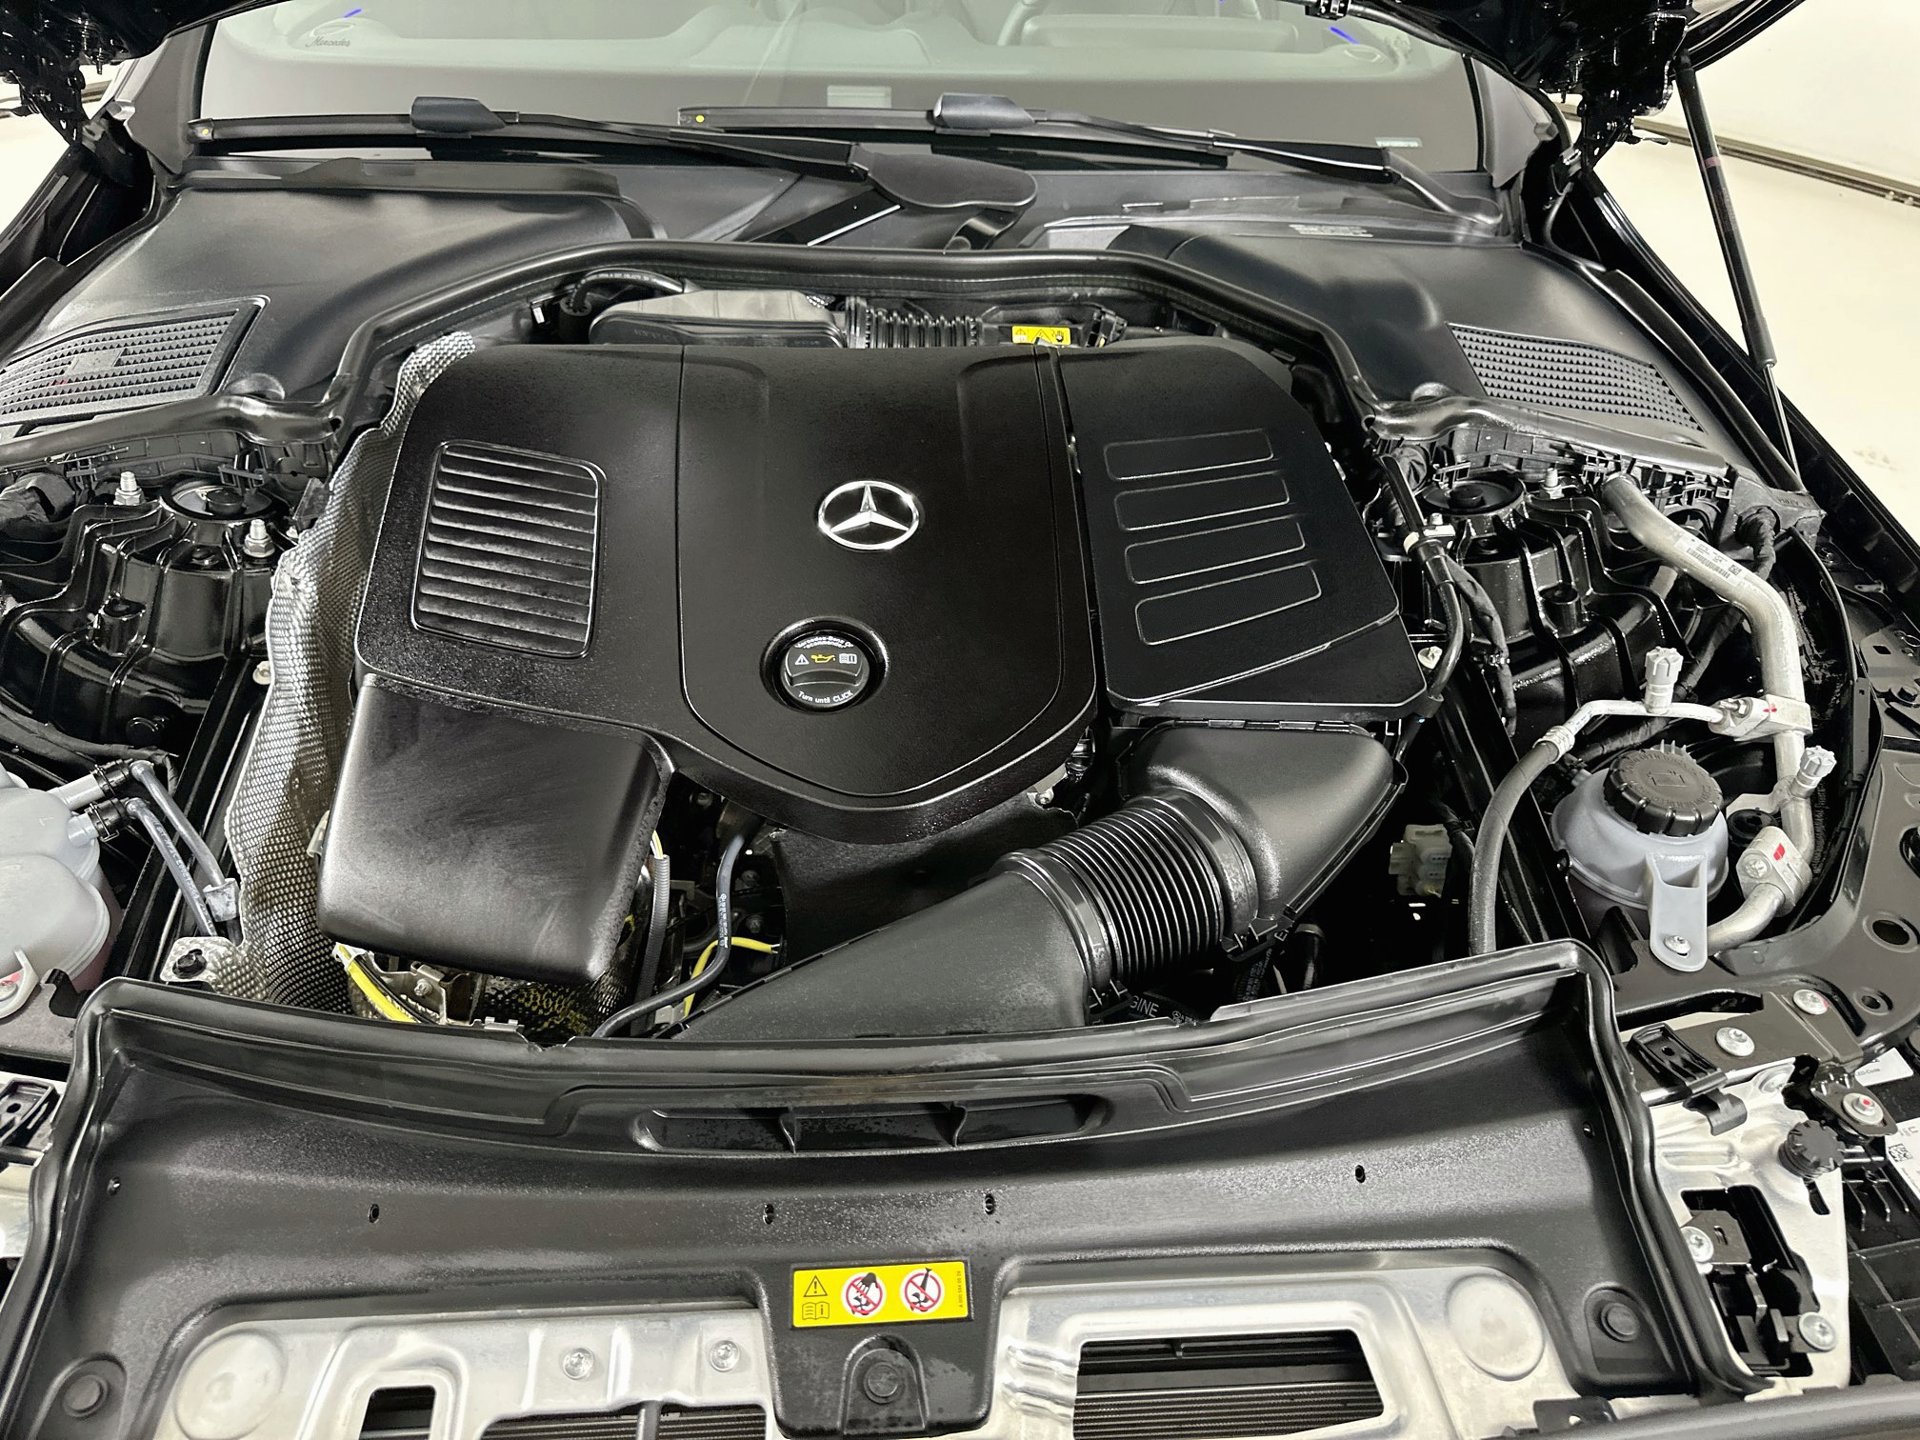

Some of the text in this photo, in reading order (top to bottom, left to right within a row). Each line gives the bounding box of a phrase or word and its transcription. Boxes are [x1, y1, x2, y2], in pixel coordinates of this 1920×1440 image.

[798, 689, 854, 704] Turn until CLICK
